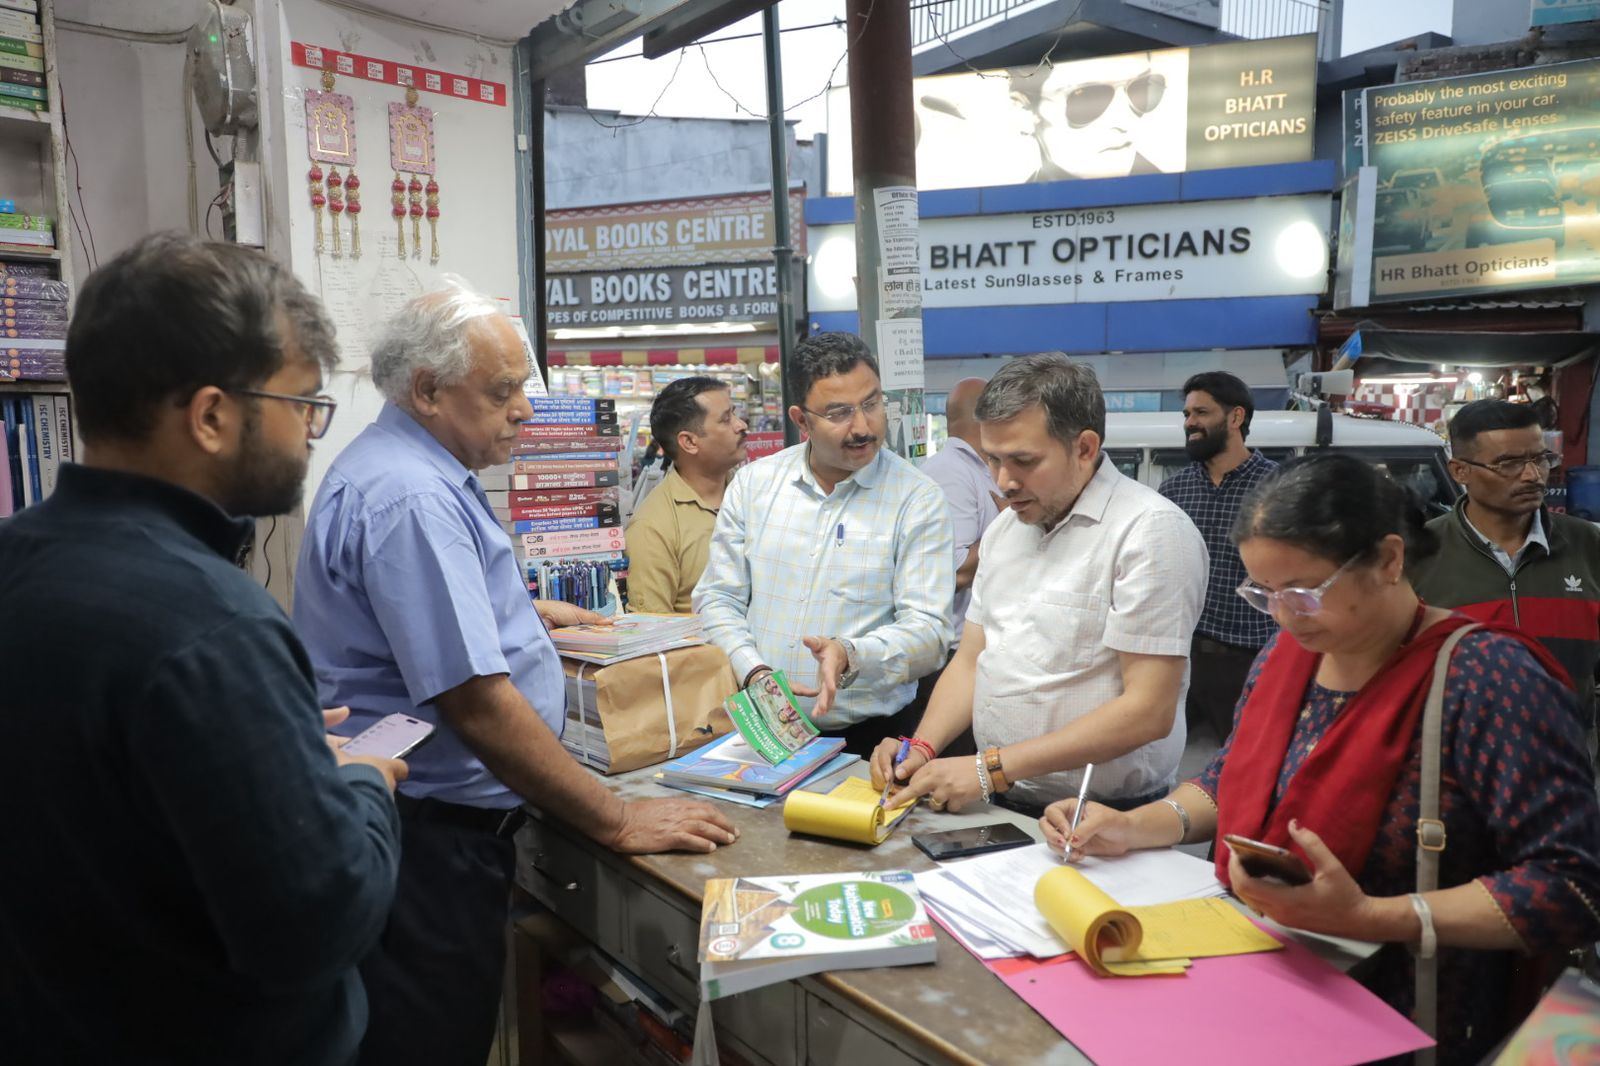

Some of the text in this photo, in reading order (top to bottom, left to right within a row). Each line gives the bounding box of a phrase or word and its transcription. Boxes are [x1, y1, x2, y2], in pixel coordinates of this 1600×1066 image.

[1241, 69, 1273, 87] H.R
[1374, 74, 1567, 108] Probably the most exciting
[1225, 93, 1287, 114] BHATT
[1375, 94, 1560, 127] safety feature in your car.
[1204, 117, 1306, 141] OPTICIANS
[1375, 113, 1558, 145] ZEISS DriveSafe Lenses
[595, 220, 669, 250] BOOKS
[676, 213, 765, 244] CENTRE
[930, 227, 1251, 270] BHATT OPTICIANS
[924, 269, 1184, 291] Latest Sunglasses & Frames
[1380, 256, 1550, 282] HR Bhatt Opticians
[591, 273, 672, 304] BOOKS
[683, 266, 777, 300] CENTRE
[884, 281, 904, 292] लोन
[572, 310, 589, 322] OF
[591, 307, 673, 322] COMPETITIVE
[680, 304, 724, 318] BOOKS
[730, 303, 738, 316] &
[40, 404, 52, 459] ISC CHEMISTRY
[60, 420, 69, 458] CHEMISTRY
[827, 899, 844, 924] Today
[842, 884, 866, 937] Mathematics
[862, 901, 878, 918] New
